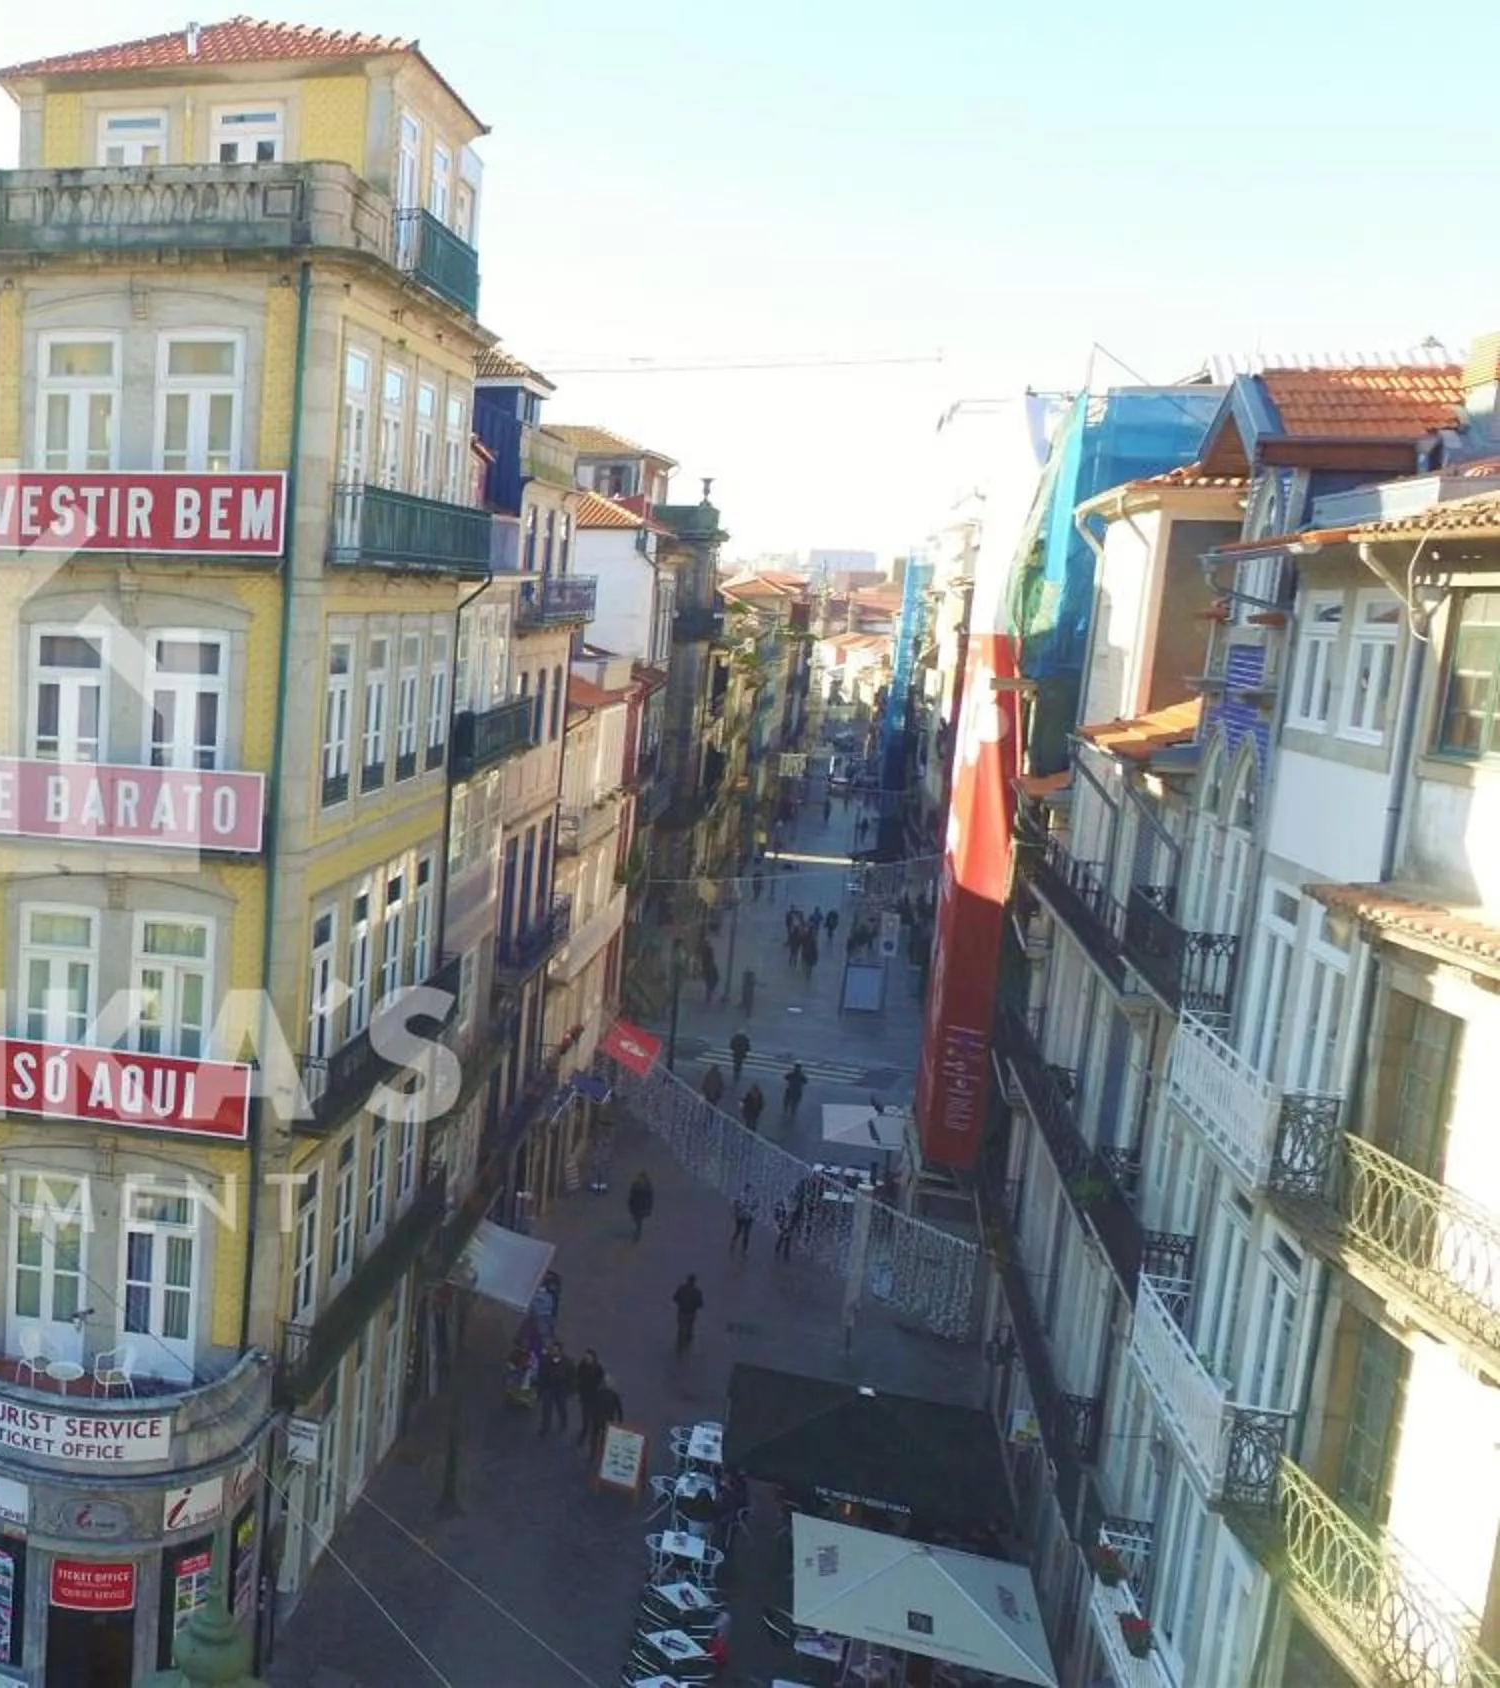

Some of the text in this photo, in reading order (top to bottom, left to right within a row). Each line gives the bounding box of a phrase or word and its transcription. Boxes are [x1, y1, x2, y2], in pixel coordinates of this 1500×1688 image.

[173, 487, 276, 542] BEM
[46, 774, 239, 835] BARATO
[11, 1049, 195, 1119] SÓ AQUI
[60, 1441, 125, 1460] OFFICE
[64, 1418, 163, 1440] SERVICE
